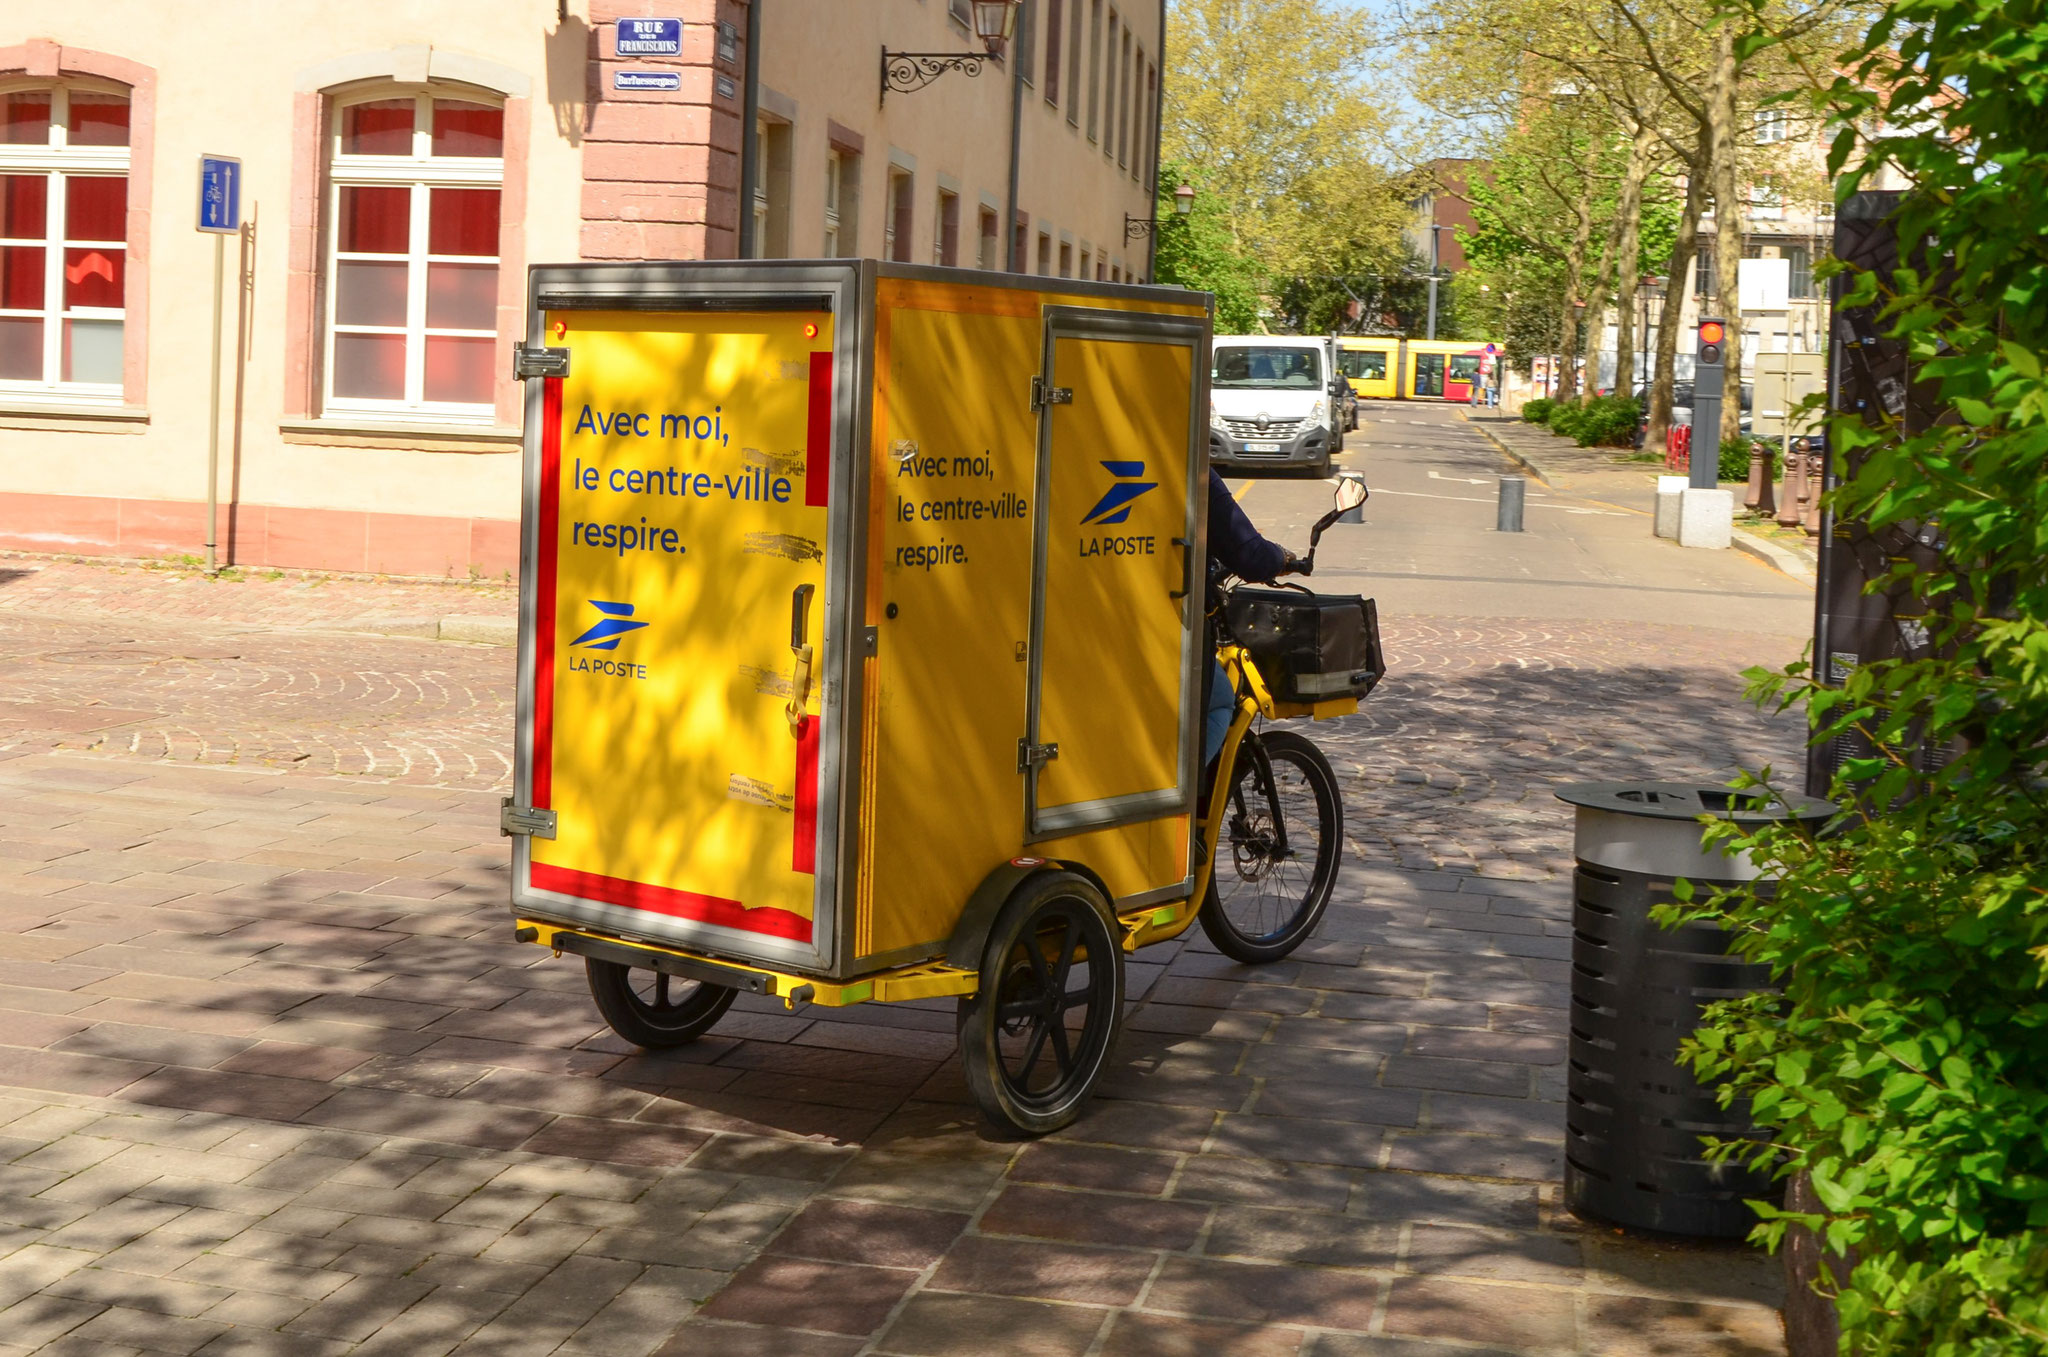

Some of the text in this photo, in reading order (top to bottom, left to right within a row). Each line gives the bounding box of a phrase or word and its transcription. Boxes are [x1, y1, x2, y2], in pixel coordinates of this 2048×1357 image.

[633, 21, 664, 34] RUE
[619, 40, 678, 52] FRANCISCAINS
[574, 404, 729, 448] Avec moi,
[574, 457, 792, 503] le centre-ville
[897, 449, 994, 481] Avec moi,
[897, 492, 1027, 522] le centre-ville
[572, 516, 687, 557] respire.
[1079, 536, 1156, 558] LA POSTE
[896, 537, 969, 572] respire.
[569, 656, 647, 680] LA POSTE
